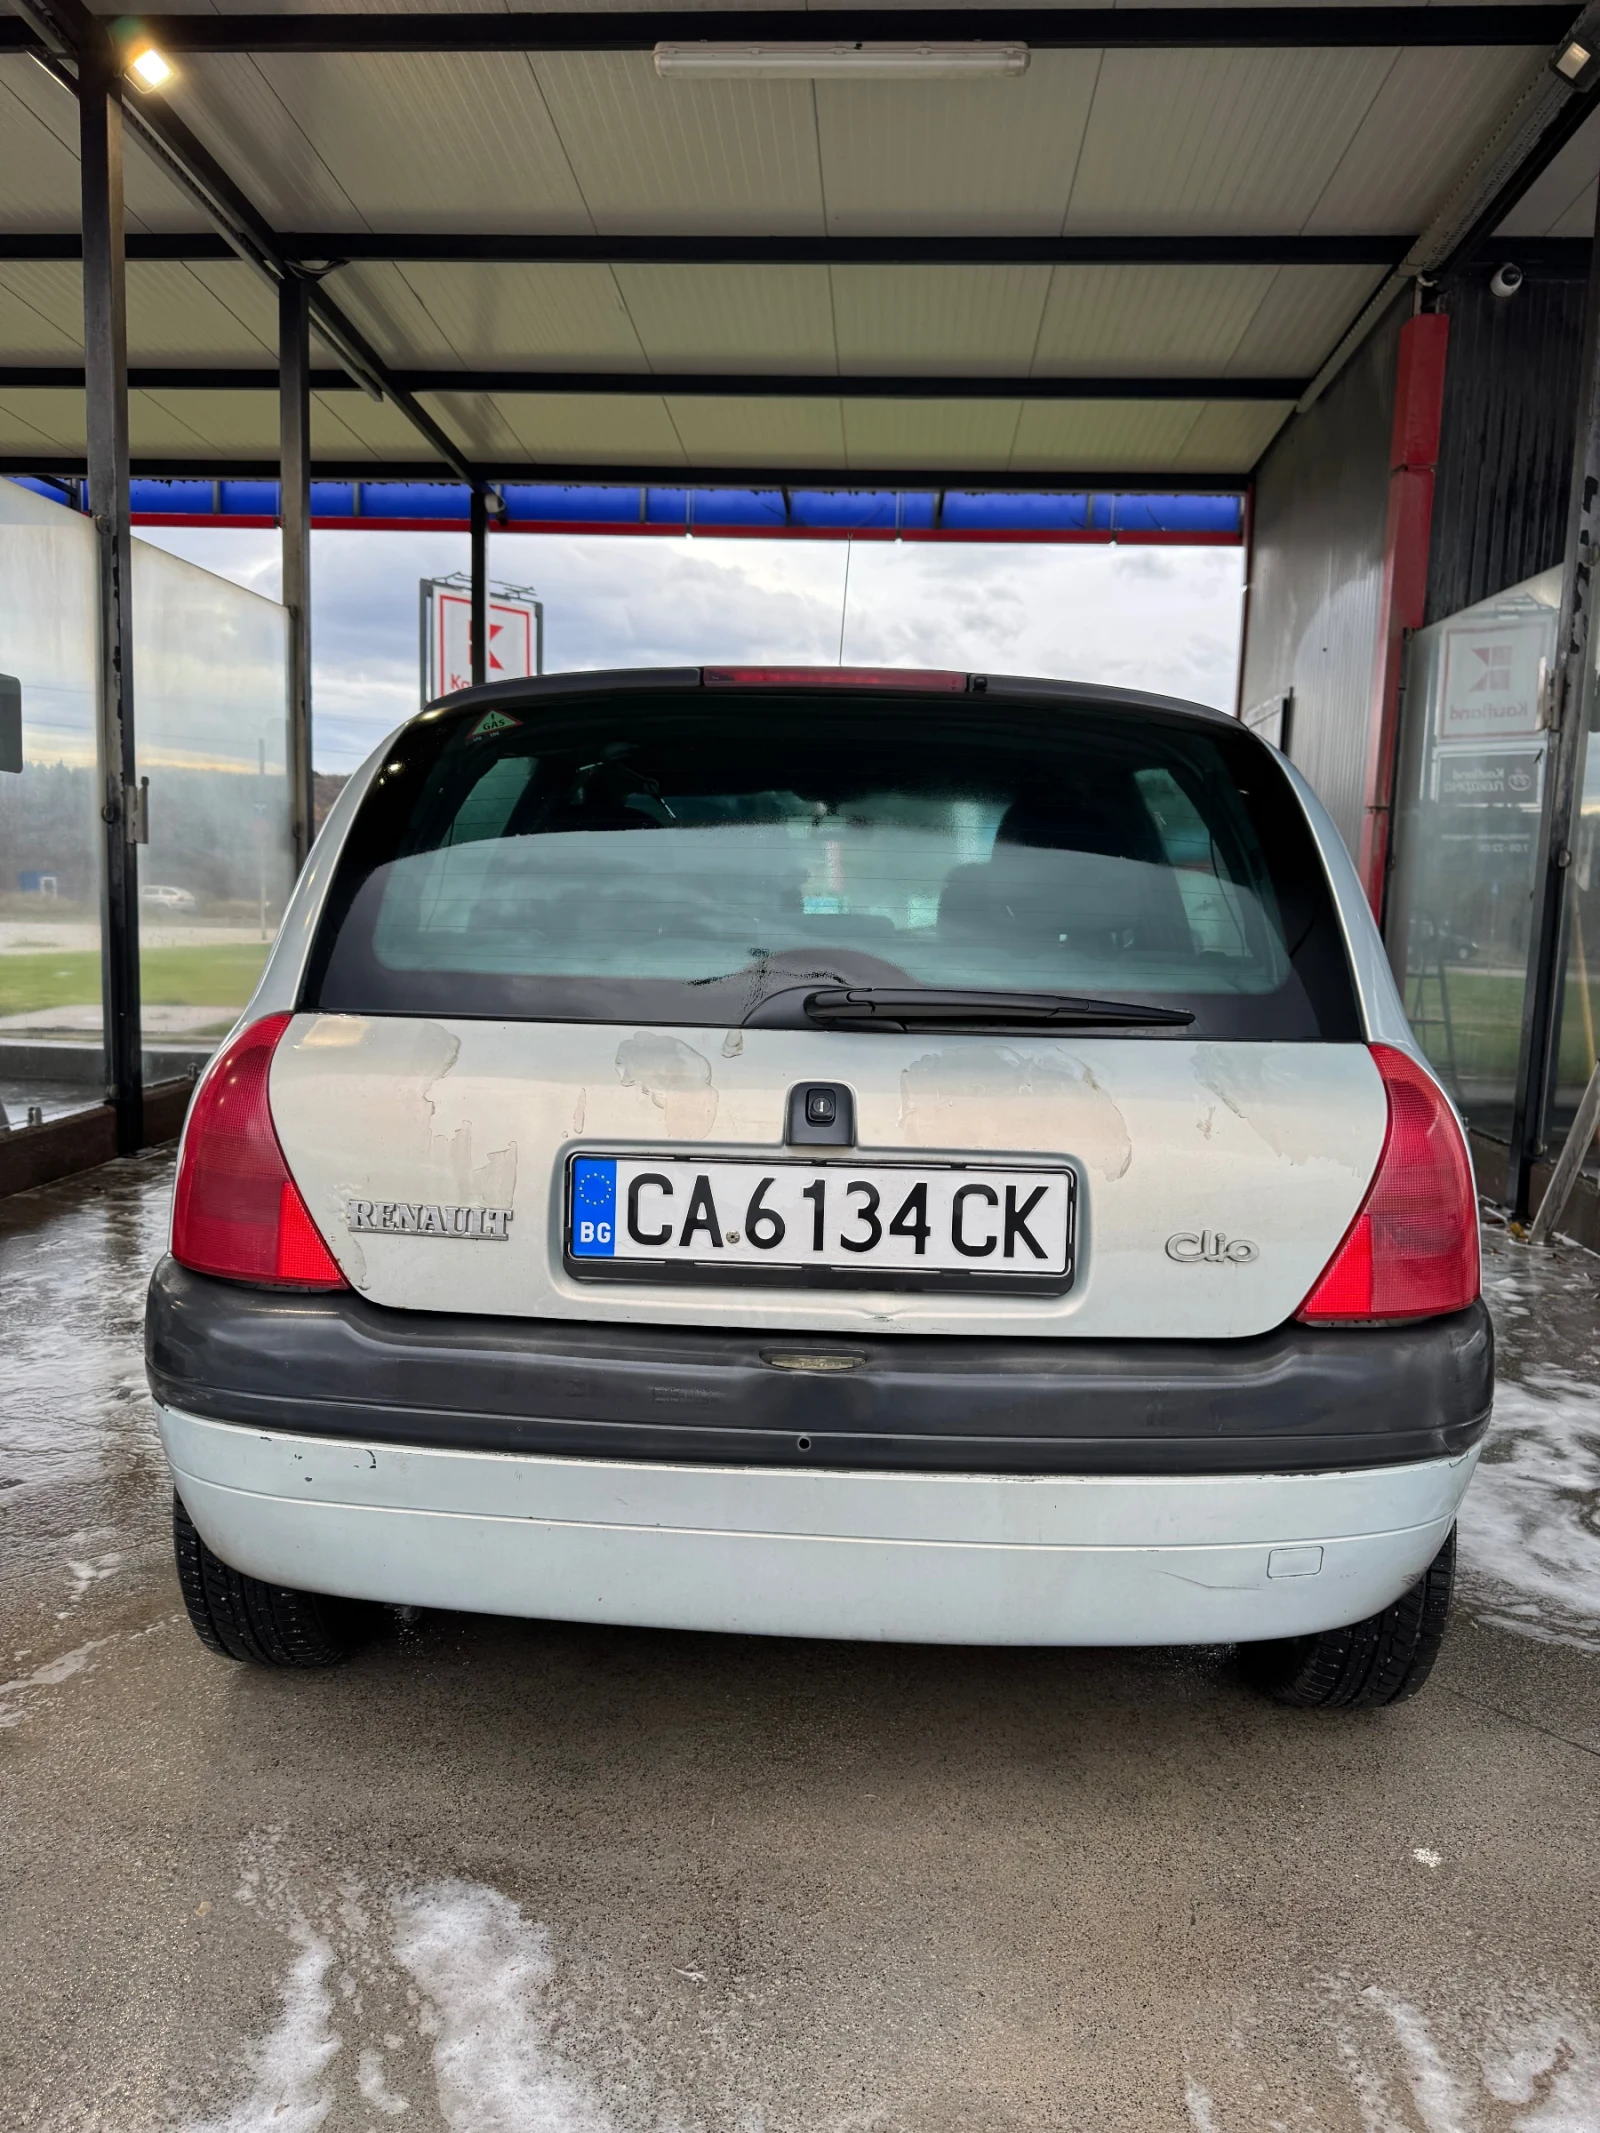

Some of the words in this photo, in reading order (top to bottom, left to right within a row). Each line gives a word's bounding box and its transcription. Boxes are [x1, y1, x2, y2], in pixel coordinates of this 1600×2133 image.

[483, 719, 505, 730] GAS
[349, 1199, 513, 1241] RENAULT
[580, 1221, 611, 1243] BG
[627, 1173, 723, 1248] CA
[744, 1177, 931, 1255] 6134
[952, 1184, 1049, 1259] CK
[1165, 1230, 1259, 1262] Clio
